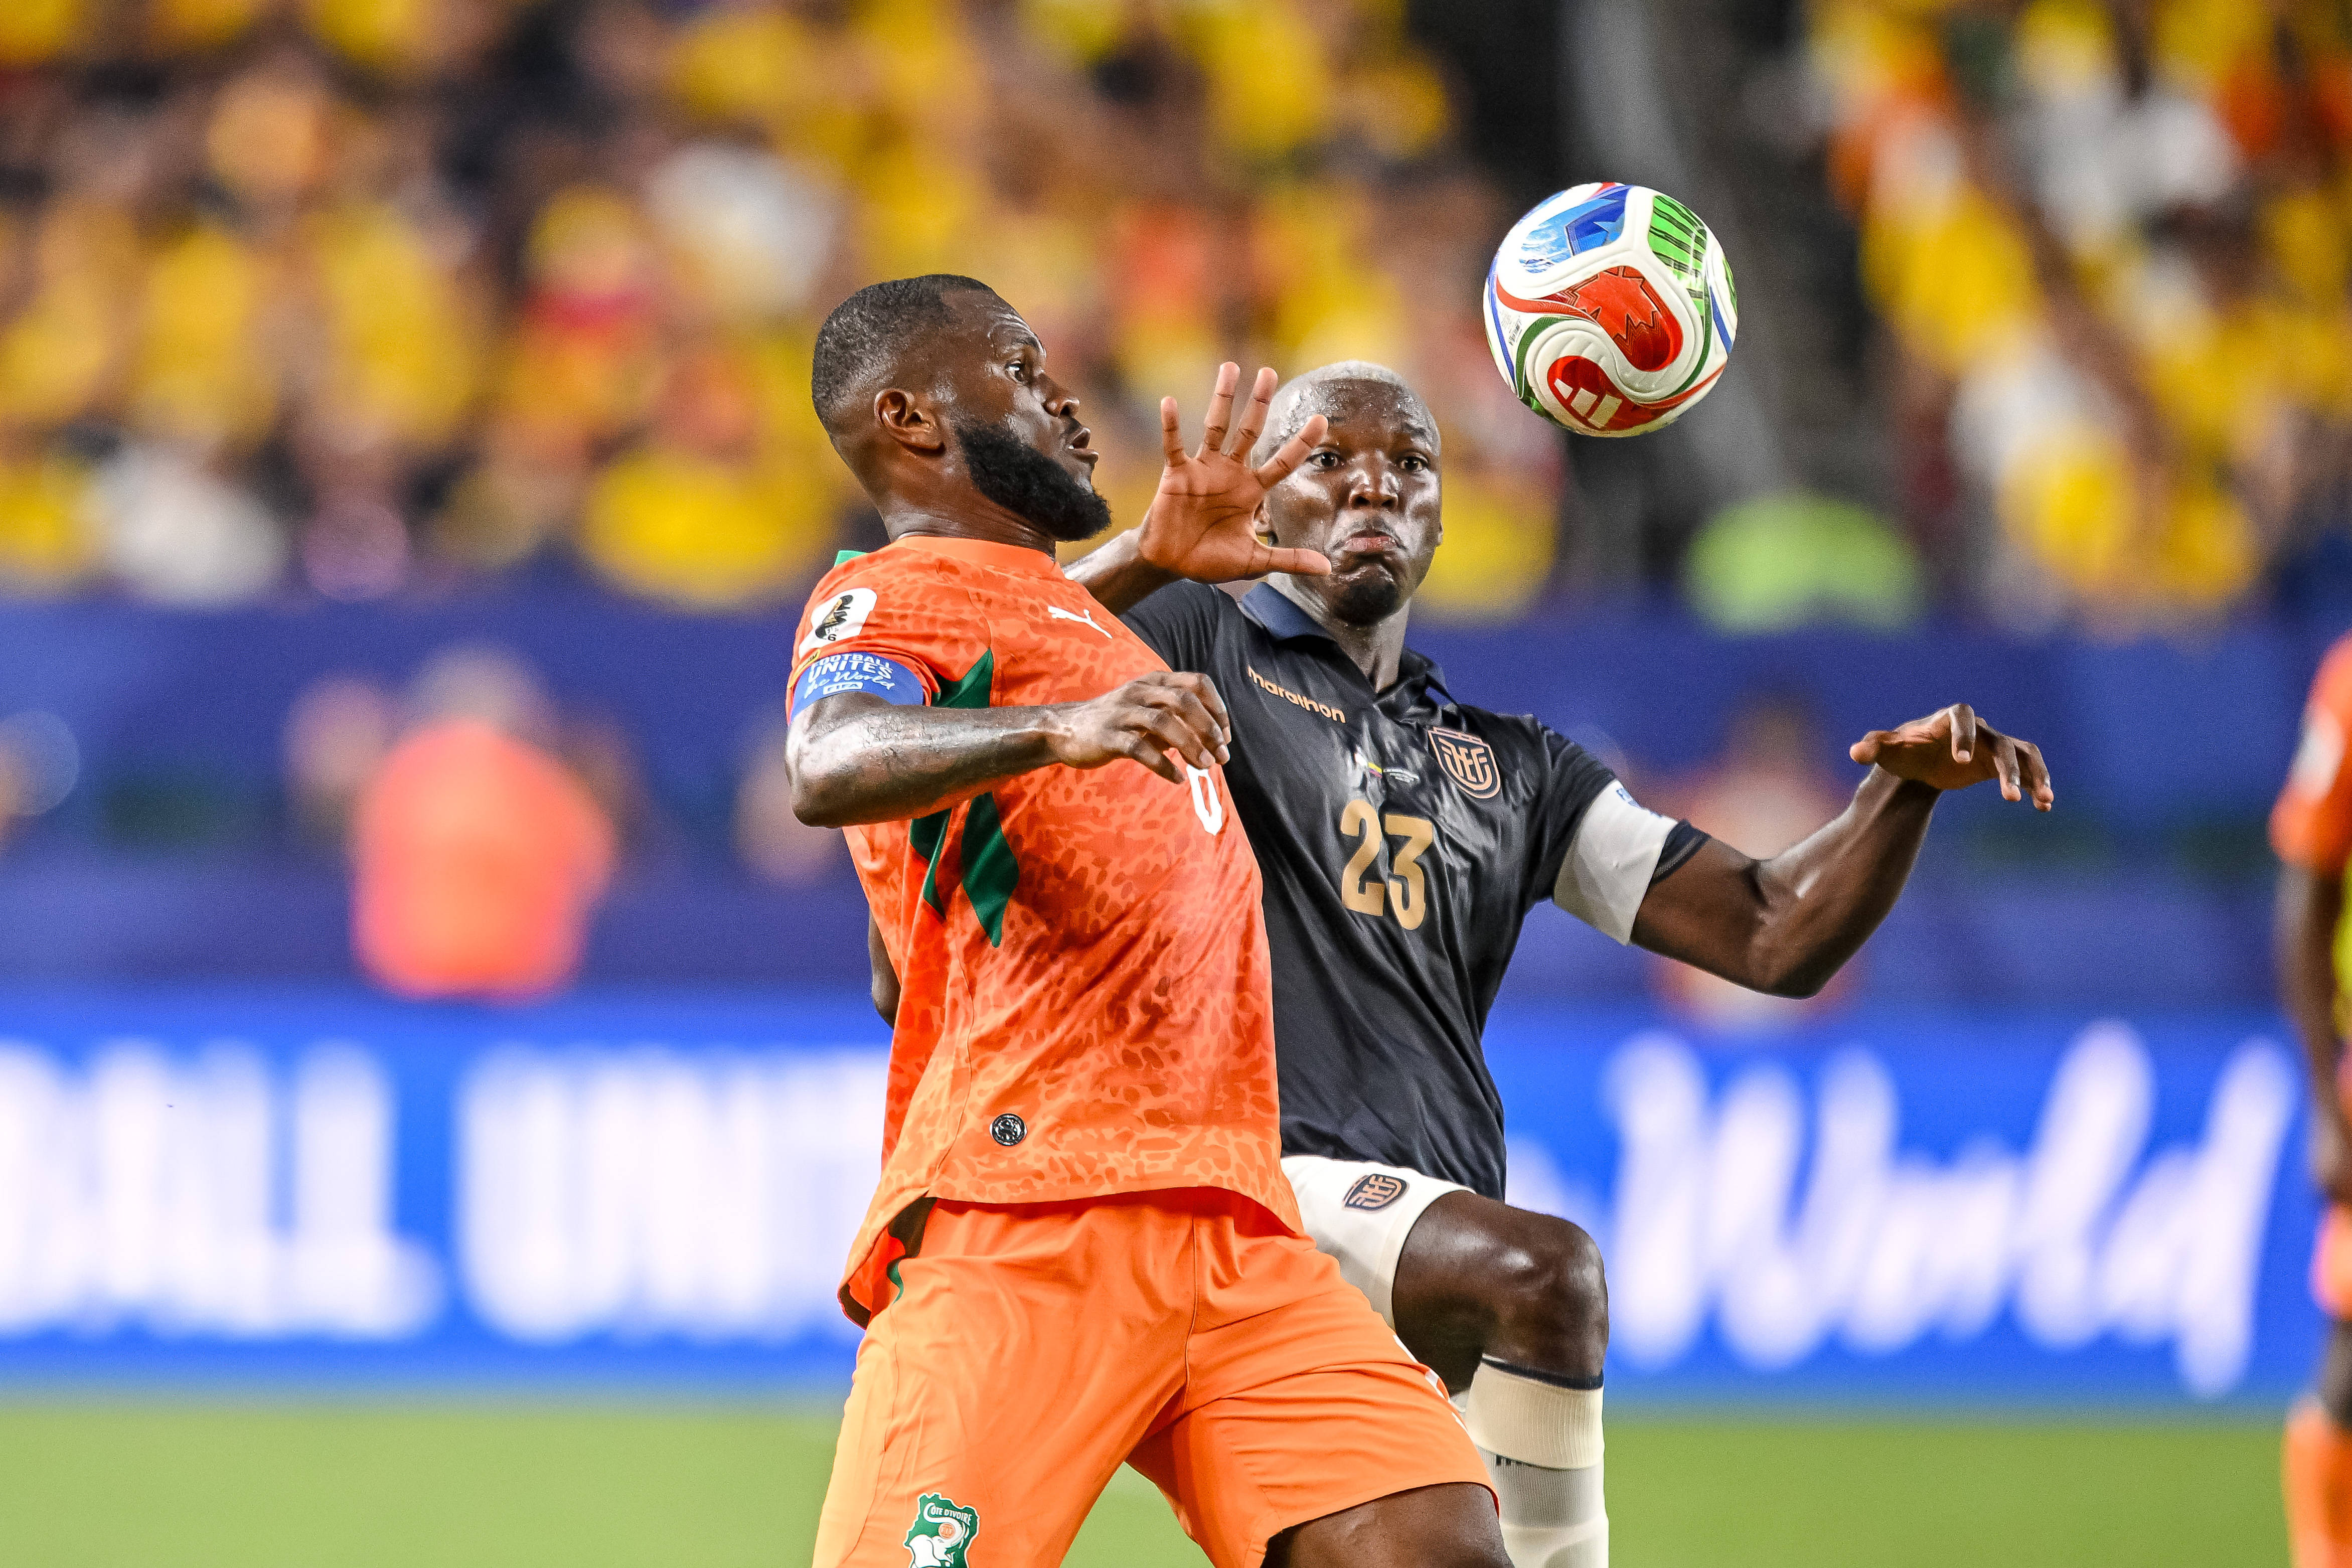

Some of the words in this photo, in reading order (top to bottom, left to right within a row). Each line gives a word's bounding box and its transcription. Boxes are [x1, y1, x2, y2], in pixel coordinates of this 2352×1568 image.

[808, 660, 892, 683] UNITES
[811, 654, 893, 671] FOOTBALL
[834, 671, 895, 690] World
[1247, 665, 1346, 723] marathon
[1340, 799, 1433, 930] 23
